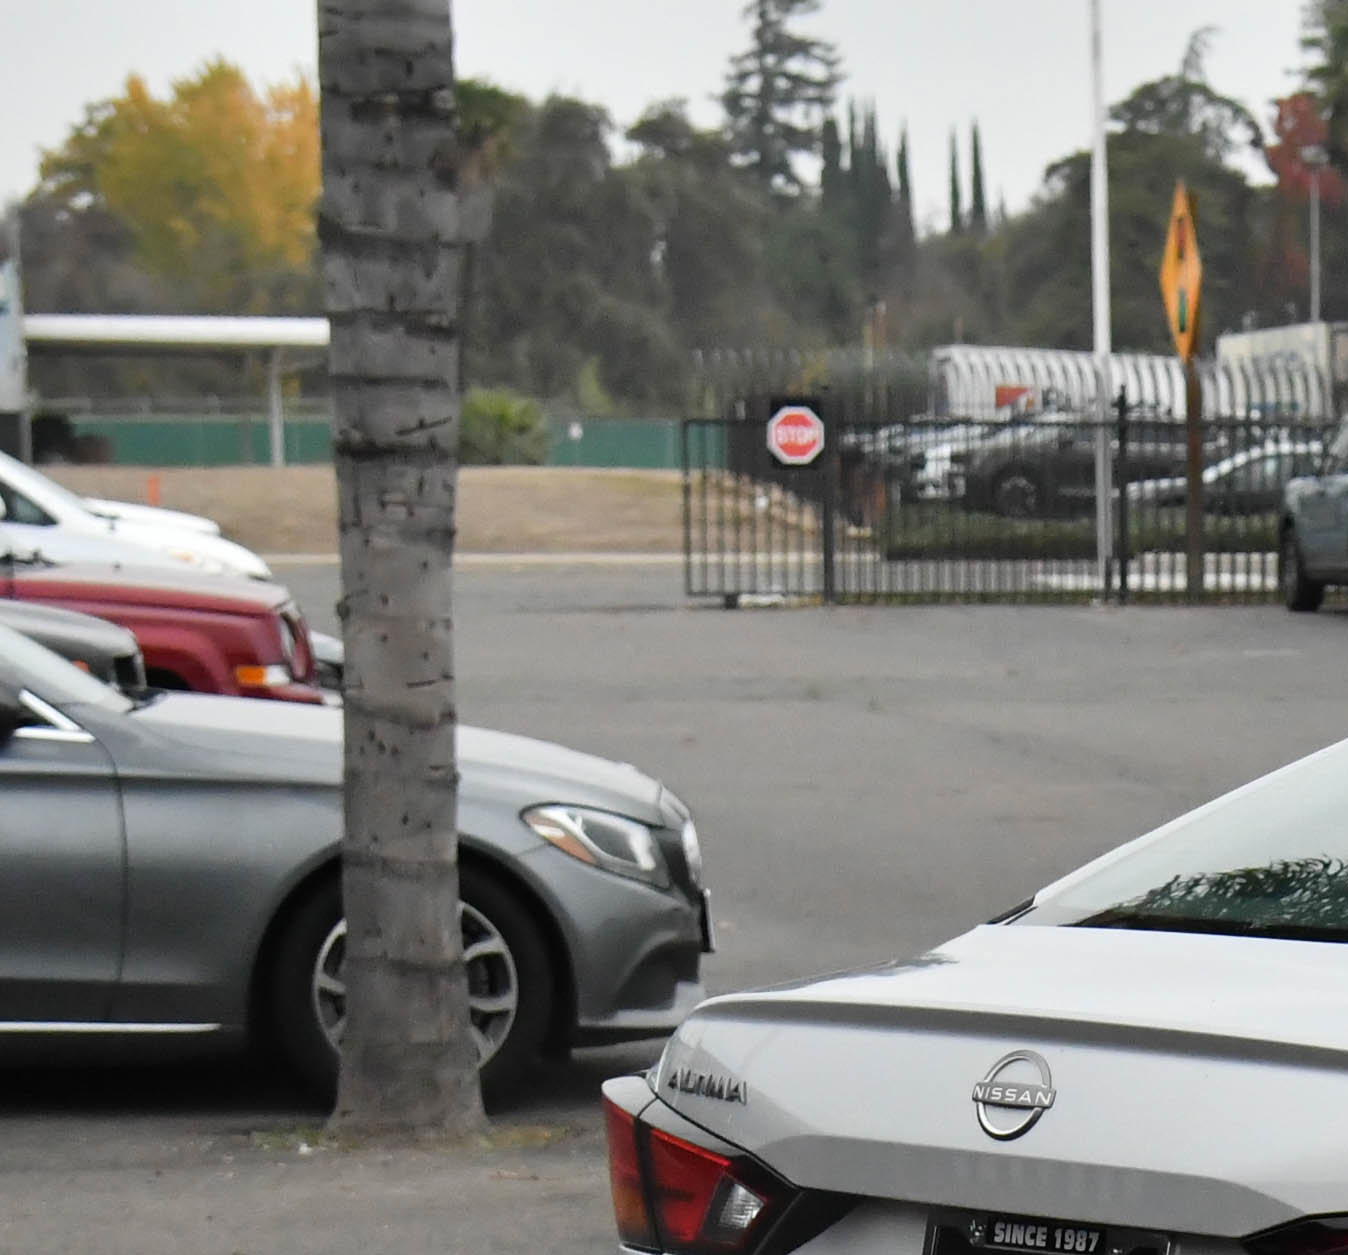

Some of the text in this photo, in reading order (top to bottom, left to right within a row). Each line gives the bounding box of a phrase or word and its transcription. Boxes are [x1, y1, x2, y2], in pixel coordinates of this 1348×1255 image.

[775, 425, 817, 444] STOP
[668, 1067, 747, 1106] ALTIMA
[972, 1085, 1052, 1105] NISSAN
[993, 1222, 1100, 1252] SINCE 1987
